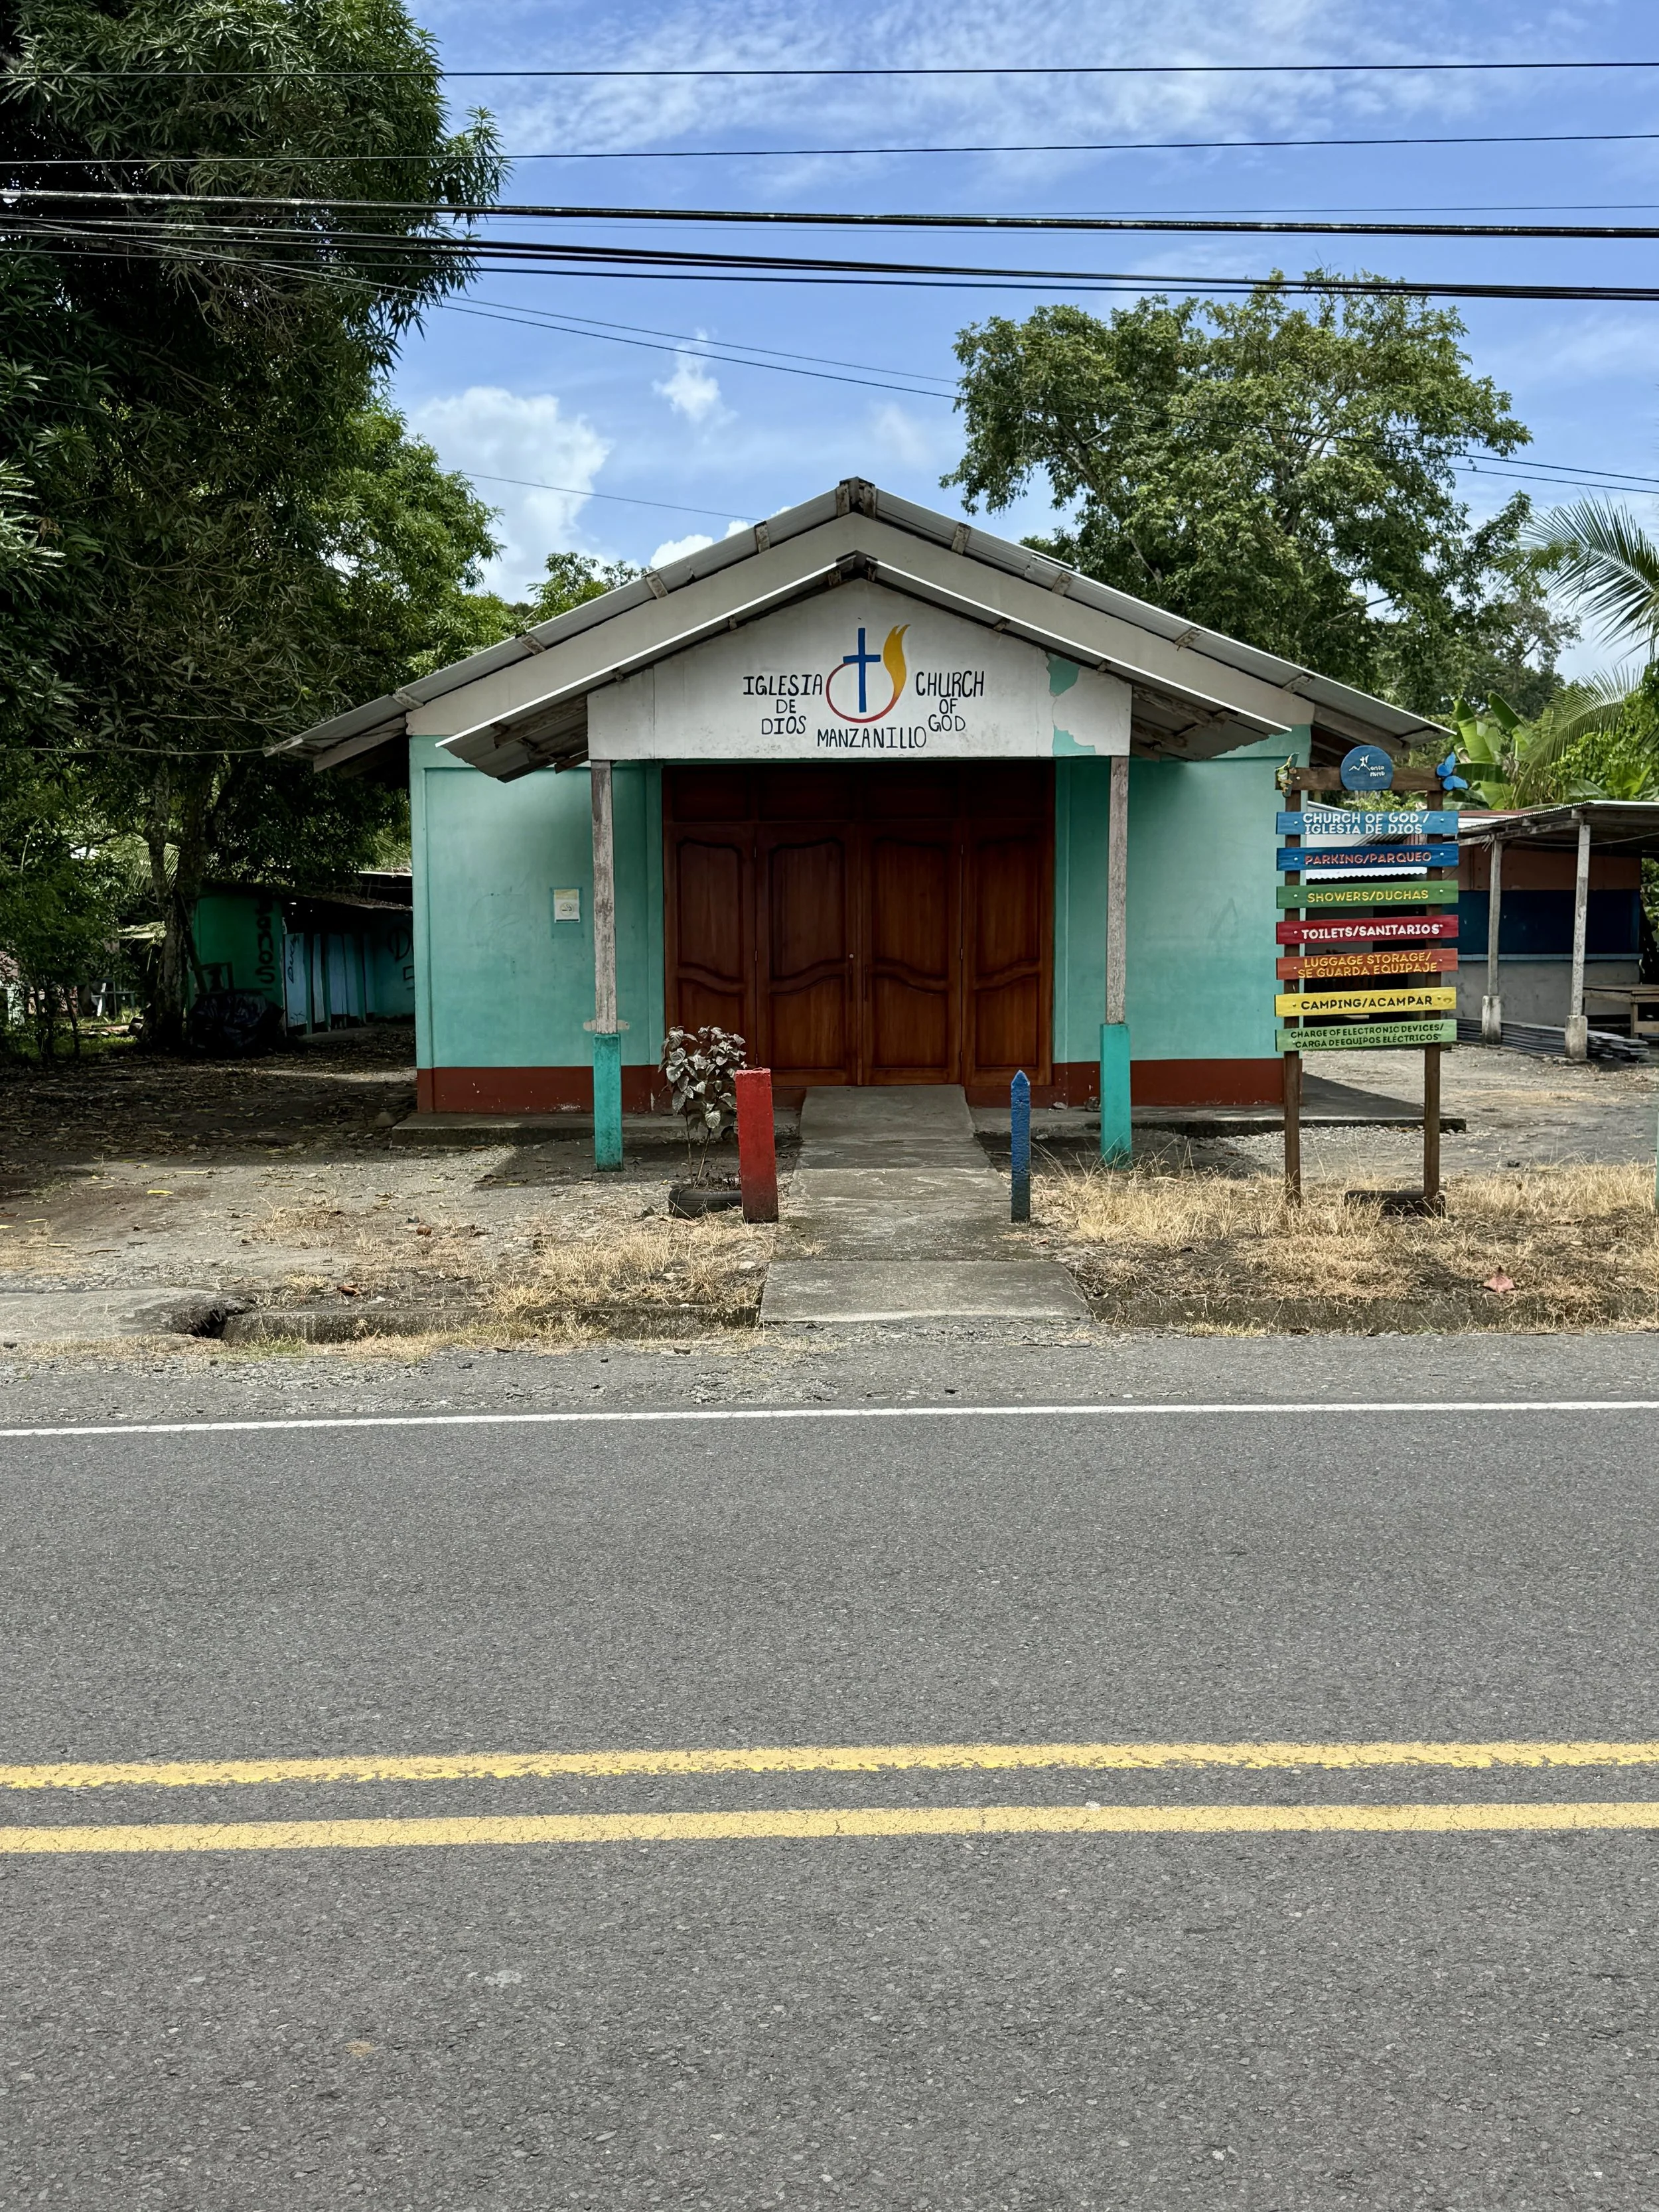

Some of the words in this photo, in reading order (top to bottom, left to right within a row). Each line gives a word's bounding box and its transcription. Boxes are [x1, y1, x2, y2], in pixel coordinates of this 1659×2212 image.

[743, 674, 823, 696] IGLESIA
[916, 670, 984, 698] CHURCH
[776, 699, 796, 713] DE
[939, 698, 958, 713] OF
[762, 716, 807, 735] DIOS
[928, 714, 966, 731] GOD
[818, 726, 926, 748] MANZANILLO
[1303, 812, 1360, 824] CHURCH
[1365, 814, 1384, 824] OF
[1388, 812, 1419, 823] GOD
[1305, 824, 1360, 834] IGLESIA
[1365, 824, 1383, 834] DE
[1388, 824, 1423, 834] DIOS
[1305, 851, 1431, 865] PARKING/PARQUEO
[1307, 890, 1429, 903] SHOWERS/DUCHAS
[1301, 924, 1440, 939] TOILETS/SANITARIOS
[1304, 955, 1363, 968] LUGGAGE
[1367, 952, 1431, 964] STORAGE/
[1298, 969, 1313, 978] SE
[1317, 966, 1370, 977] GUARDA
[1374, 962, 1437, 974] EQUIPAJE
[1301, 995, 1433, 1009] CAMPING/ACAMPAR
[1291, 1029, 1327, 1038] CHARGE
[1342, 1025, 1400, 1035] ELECTRONIC
[1401, 1023, 1444, 1033] DEVICES/
[1383, 1033, 1439, 1043] ELÉCTRICOS
